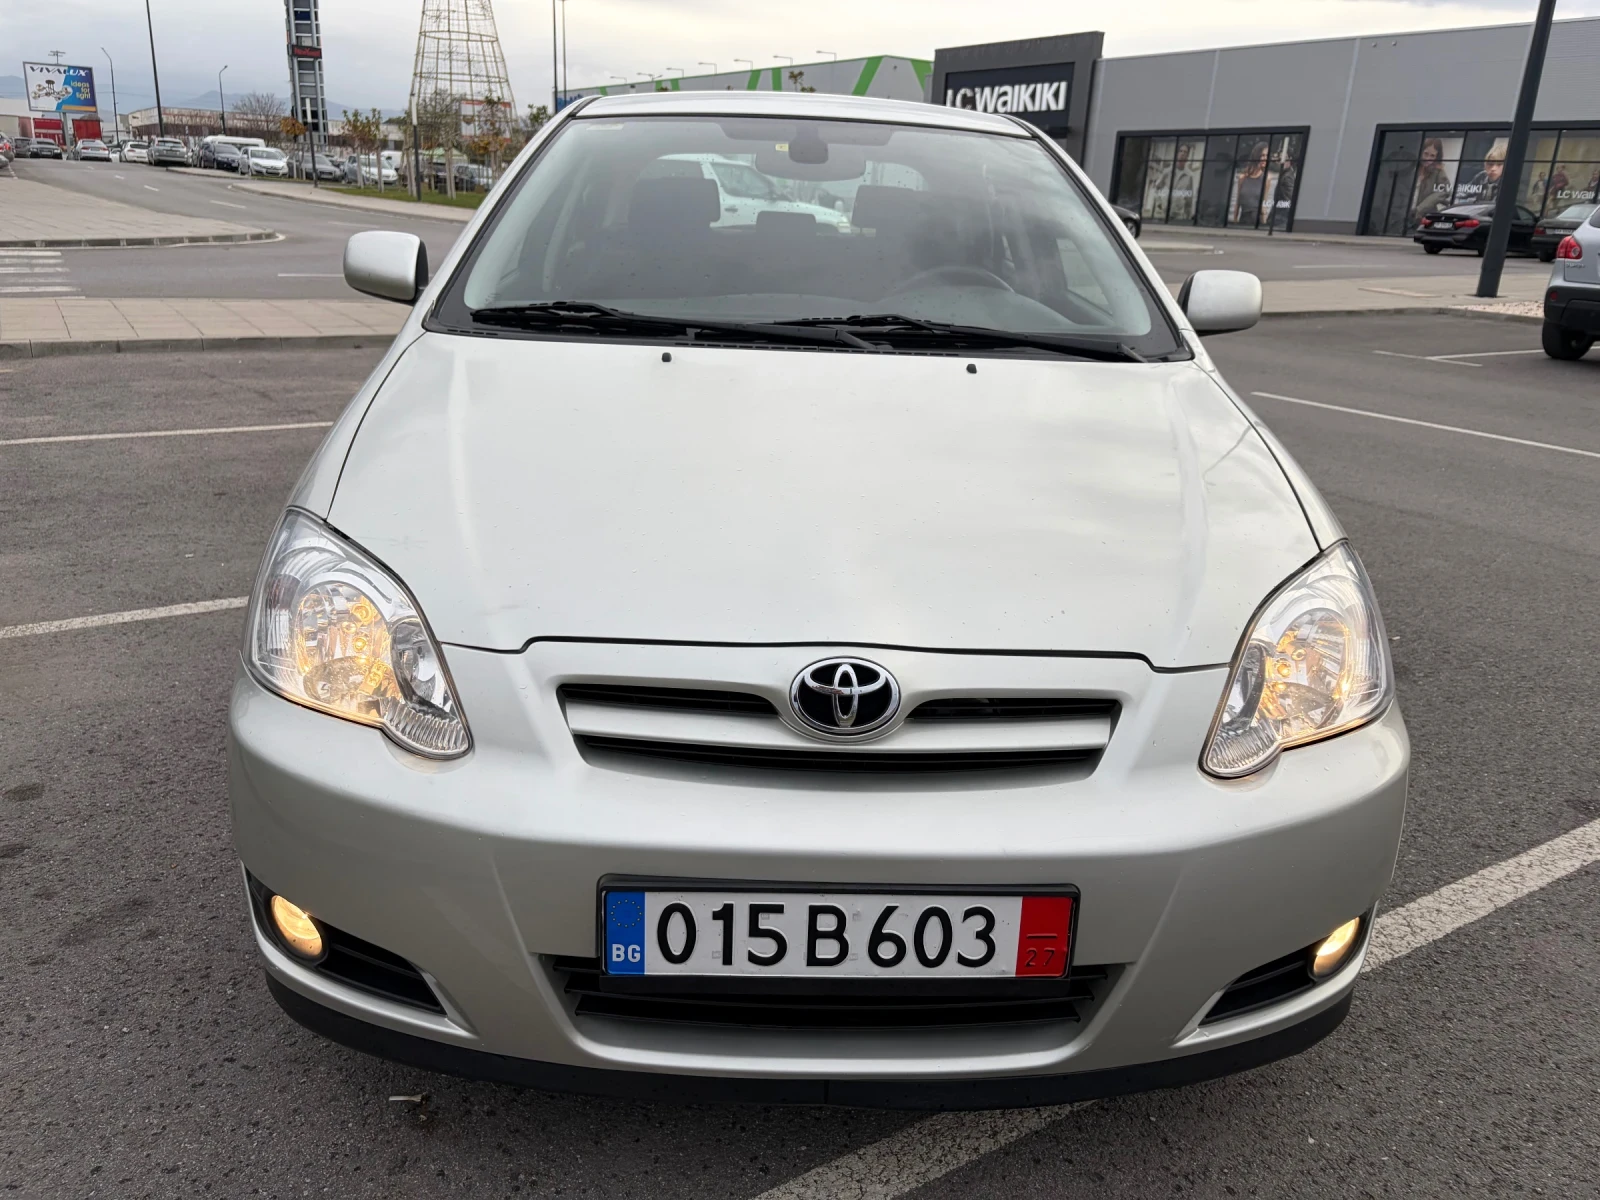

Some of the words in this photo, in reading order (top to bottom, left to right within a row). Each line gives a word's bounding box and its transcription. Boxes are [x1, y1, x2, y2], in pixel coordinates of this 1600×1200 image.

[30, 66, 88, 76] VIVALUX
[1557, 190, 1570, 198] LC
[657, 902, 996, 968] 015B603
[612, 943, 641, 962] BG
[1024, 947, 1055, 967] 27
